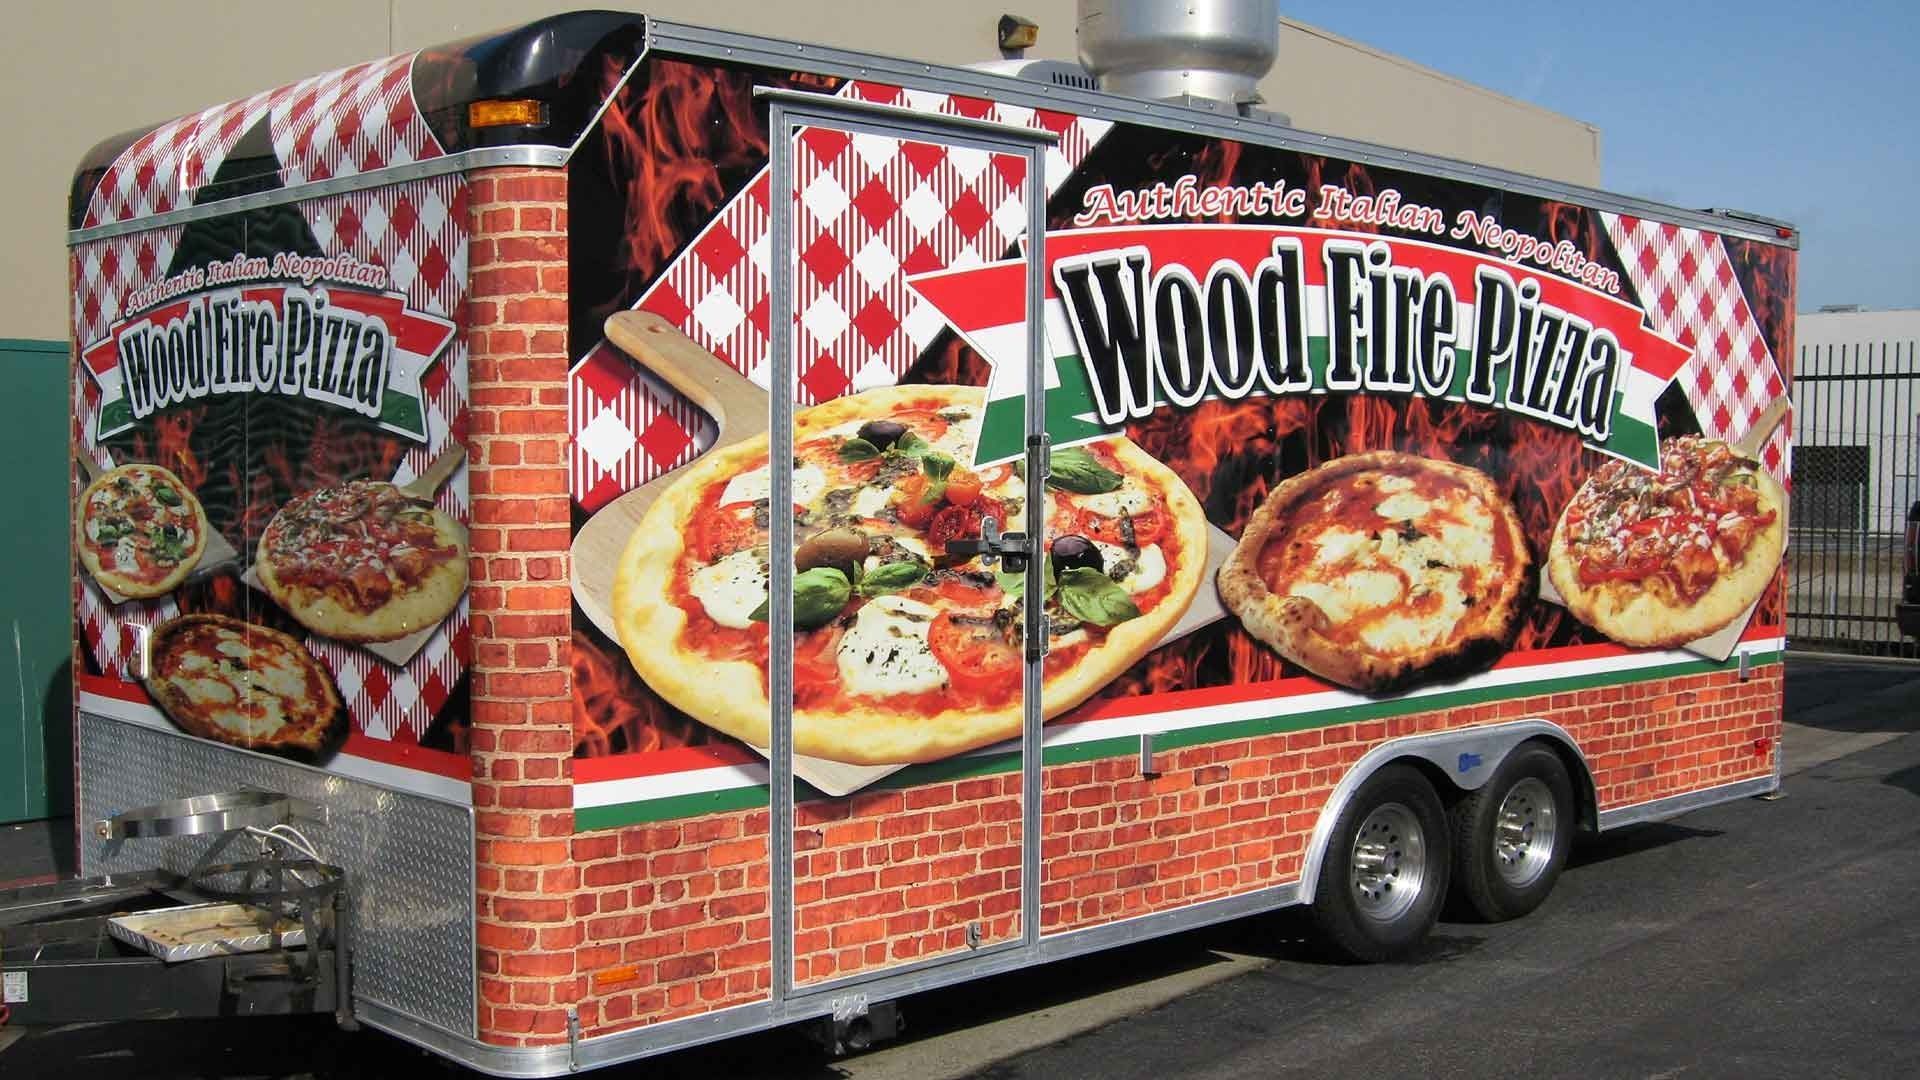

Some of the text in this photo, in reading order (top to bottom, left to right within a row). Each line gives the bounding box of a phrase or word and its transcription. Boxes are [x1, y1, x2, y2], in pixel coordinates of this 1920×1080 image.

[127, 252, 385, 315] Authentic Italian Neopolitan
[1075, 176, 1619, 293] Authentic Italian Neopolitan
[121, 292, 385, 412] Wood Fire Pizza
[1056, 239, 1620, 438] Wood Fire Pizza
